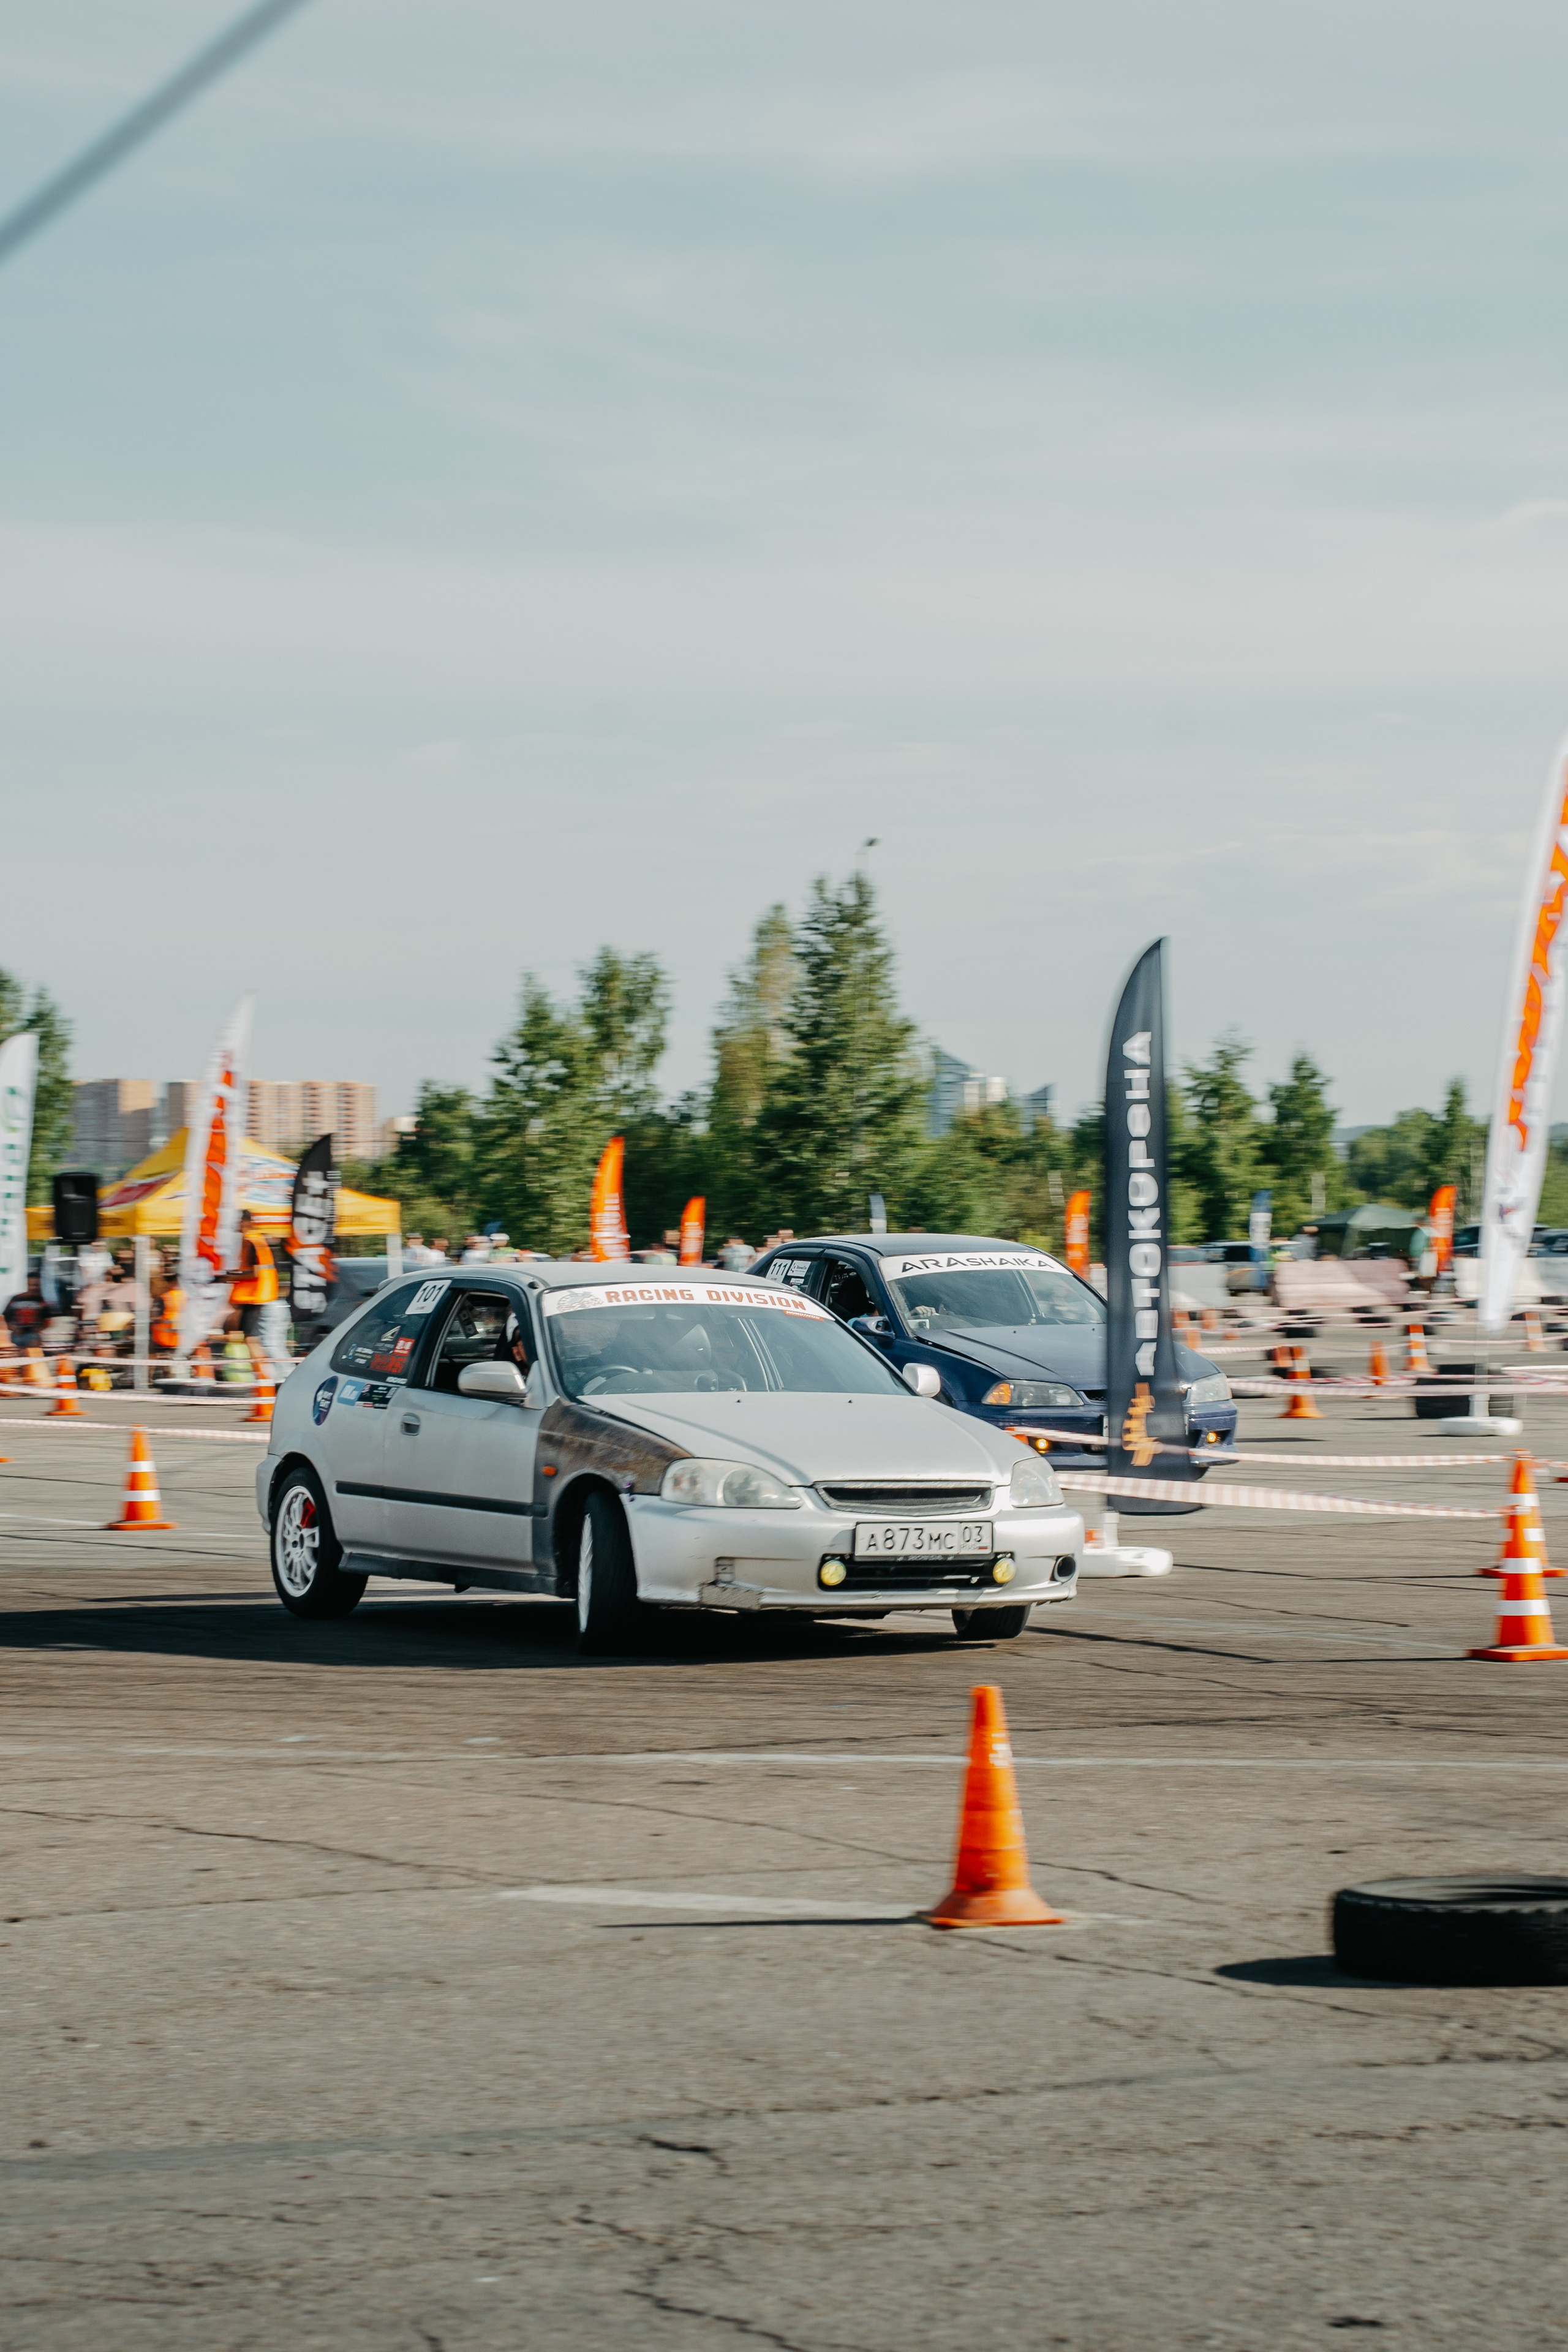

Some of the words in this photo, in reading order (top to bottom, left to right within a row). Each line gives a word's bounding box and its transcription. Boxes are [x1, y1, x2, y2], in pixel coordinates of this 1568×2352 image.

[1121, 1031, 1161, 1376] АВТОКОРОНА
[771, 1262, 788, 1276] 111
[901, 1257, 1055, 1273] ARASHAIKA
[417, 1284, 445, 1303] 101
[605, 1289, 695, 1303] RACING
[706, 1290, 806, 1310] DIVISION
[962, 1525, 984, 1542] 03
